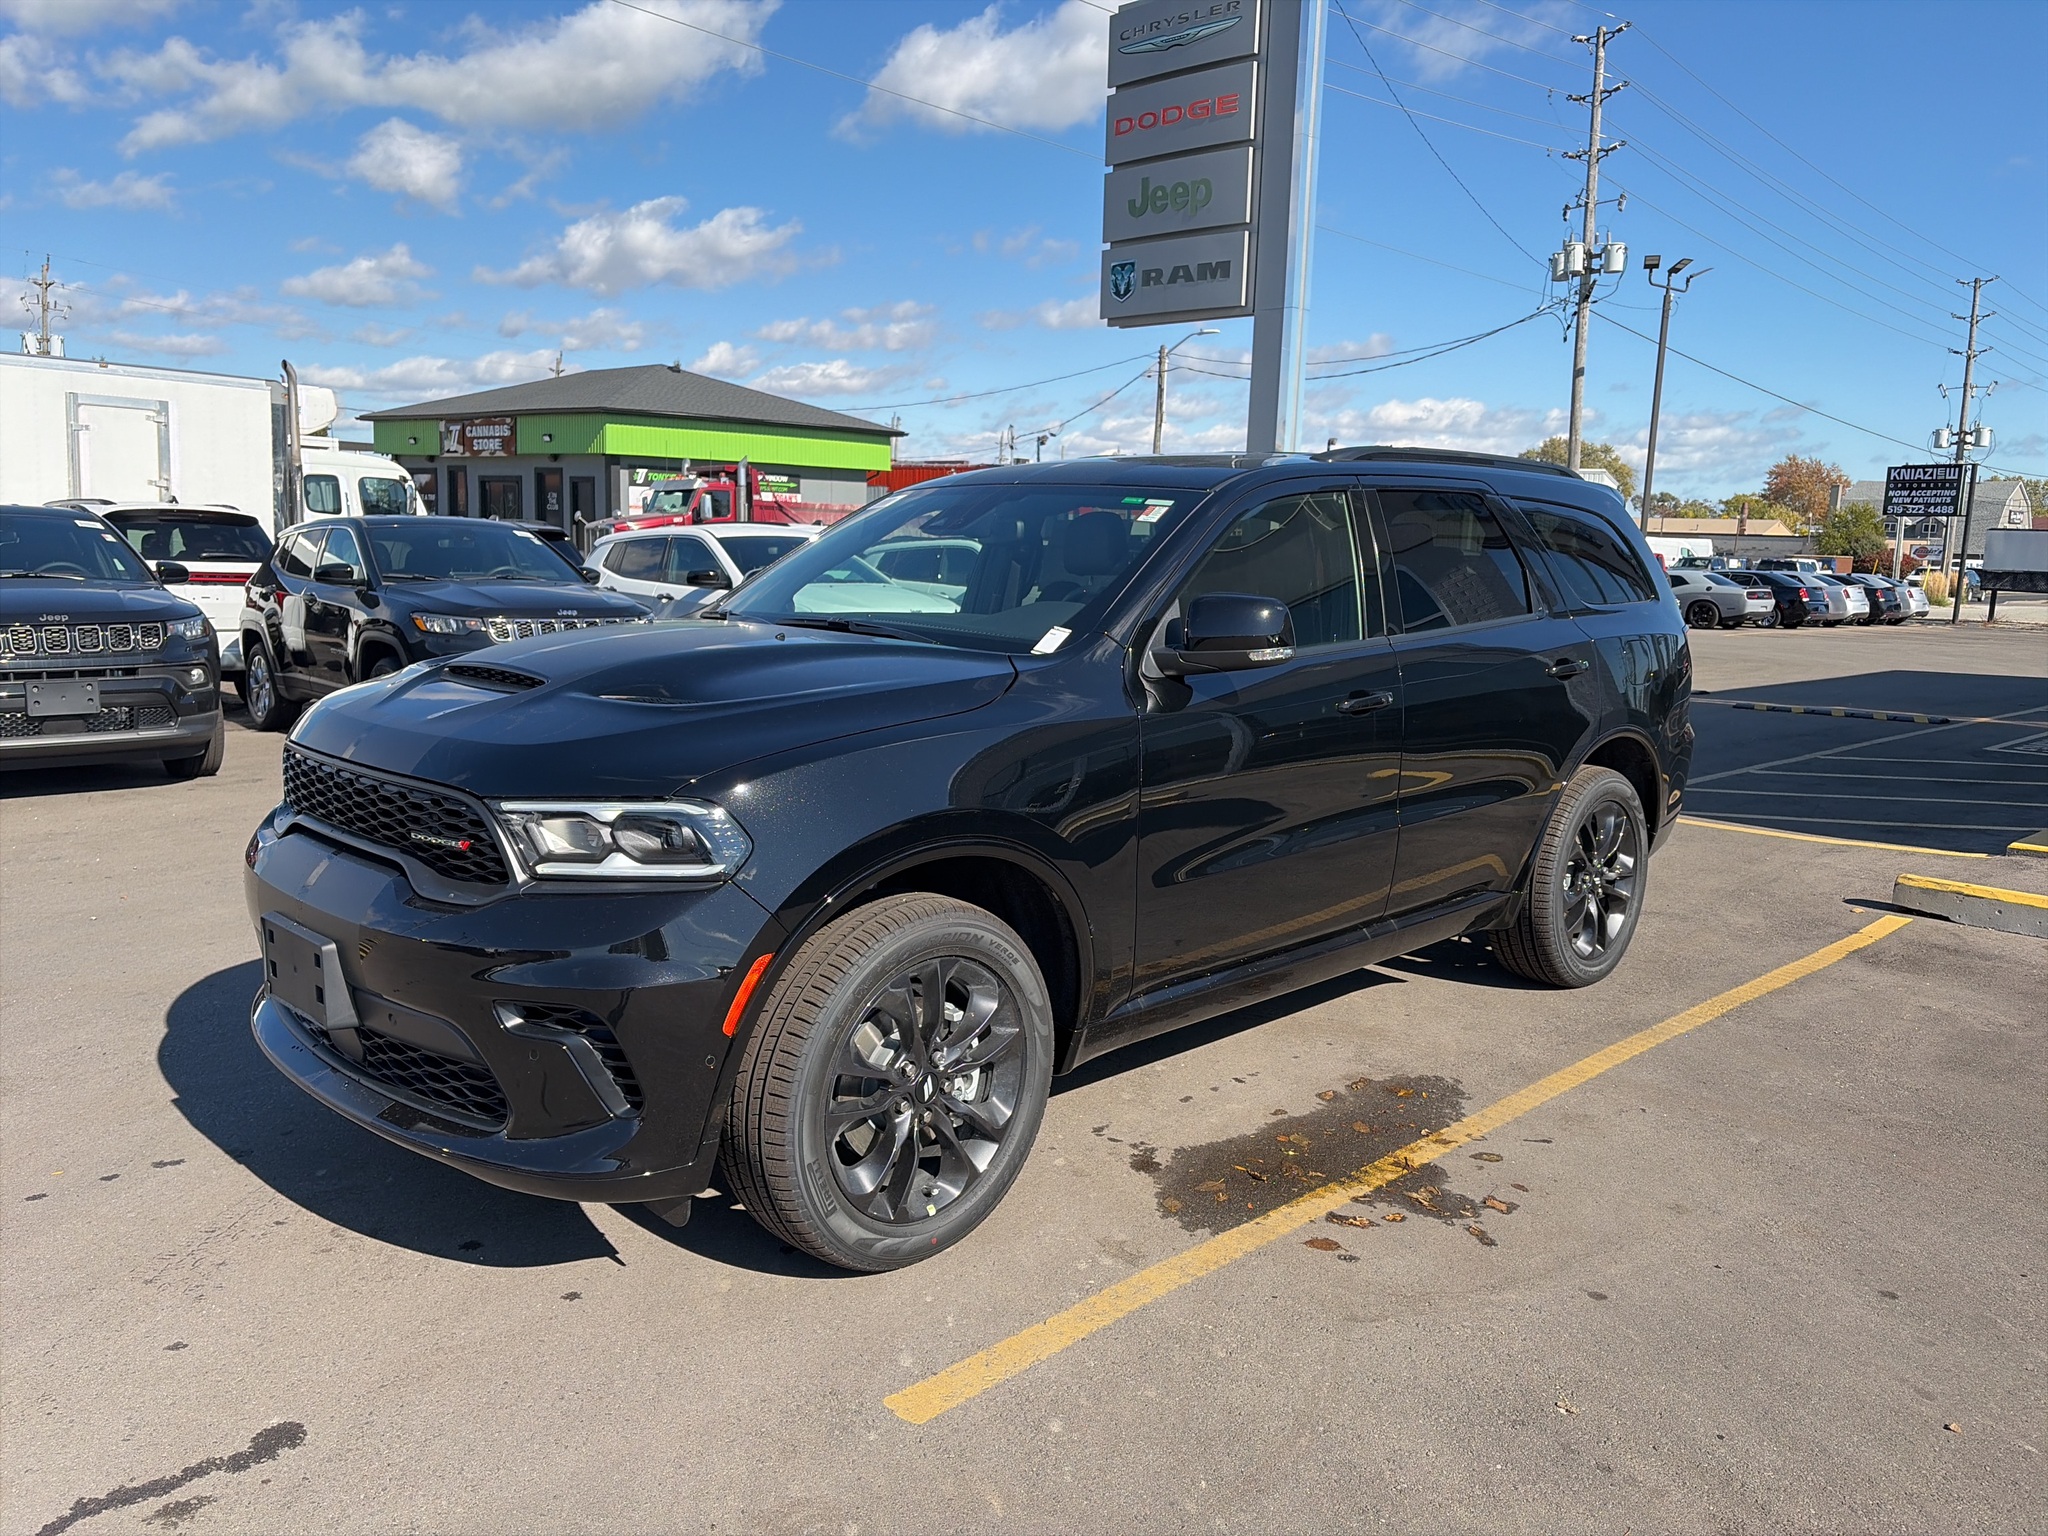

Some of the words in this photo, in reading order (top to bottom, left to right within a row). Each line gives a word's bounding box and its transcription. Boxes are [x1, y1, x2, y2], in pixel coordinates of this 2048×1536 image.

[1120, 1, 1241, 40] CHRYSLER
[1114, 93, 1240, 137] DODGE
[1128, 176, 1213, 219] Jeep
[1141, 260, 1231, 287] RAM
[466, 424, 511, 437] CANNABIS
[473, 438, 503, 451] STORE
[1910, 489, 1957, 497] ACCEPTING
[1886, 505, 1954, 514] 519-322-4488
[39, 613, 69, 622] Jeep
[410, 832, 460, 847] DODGE
[988, 939, 1021, 965] VERDE
